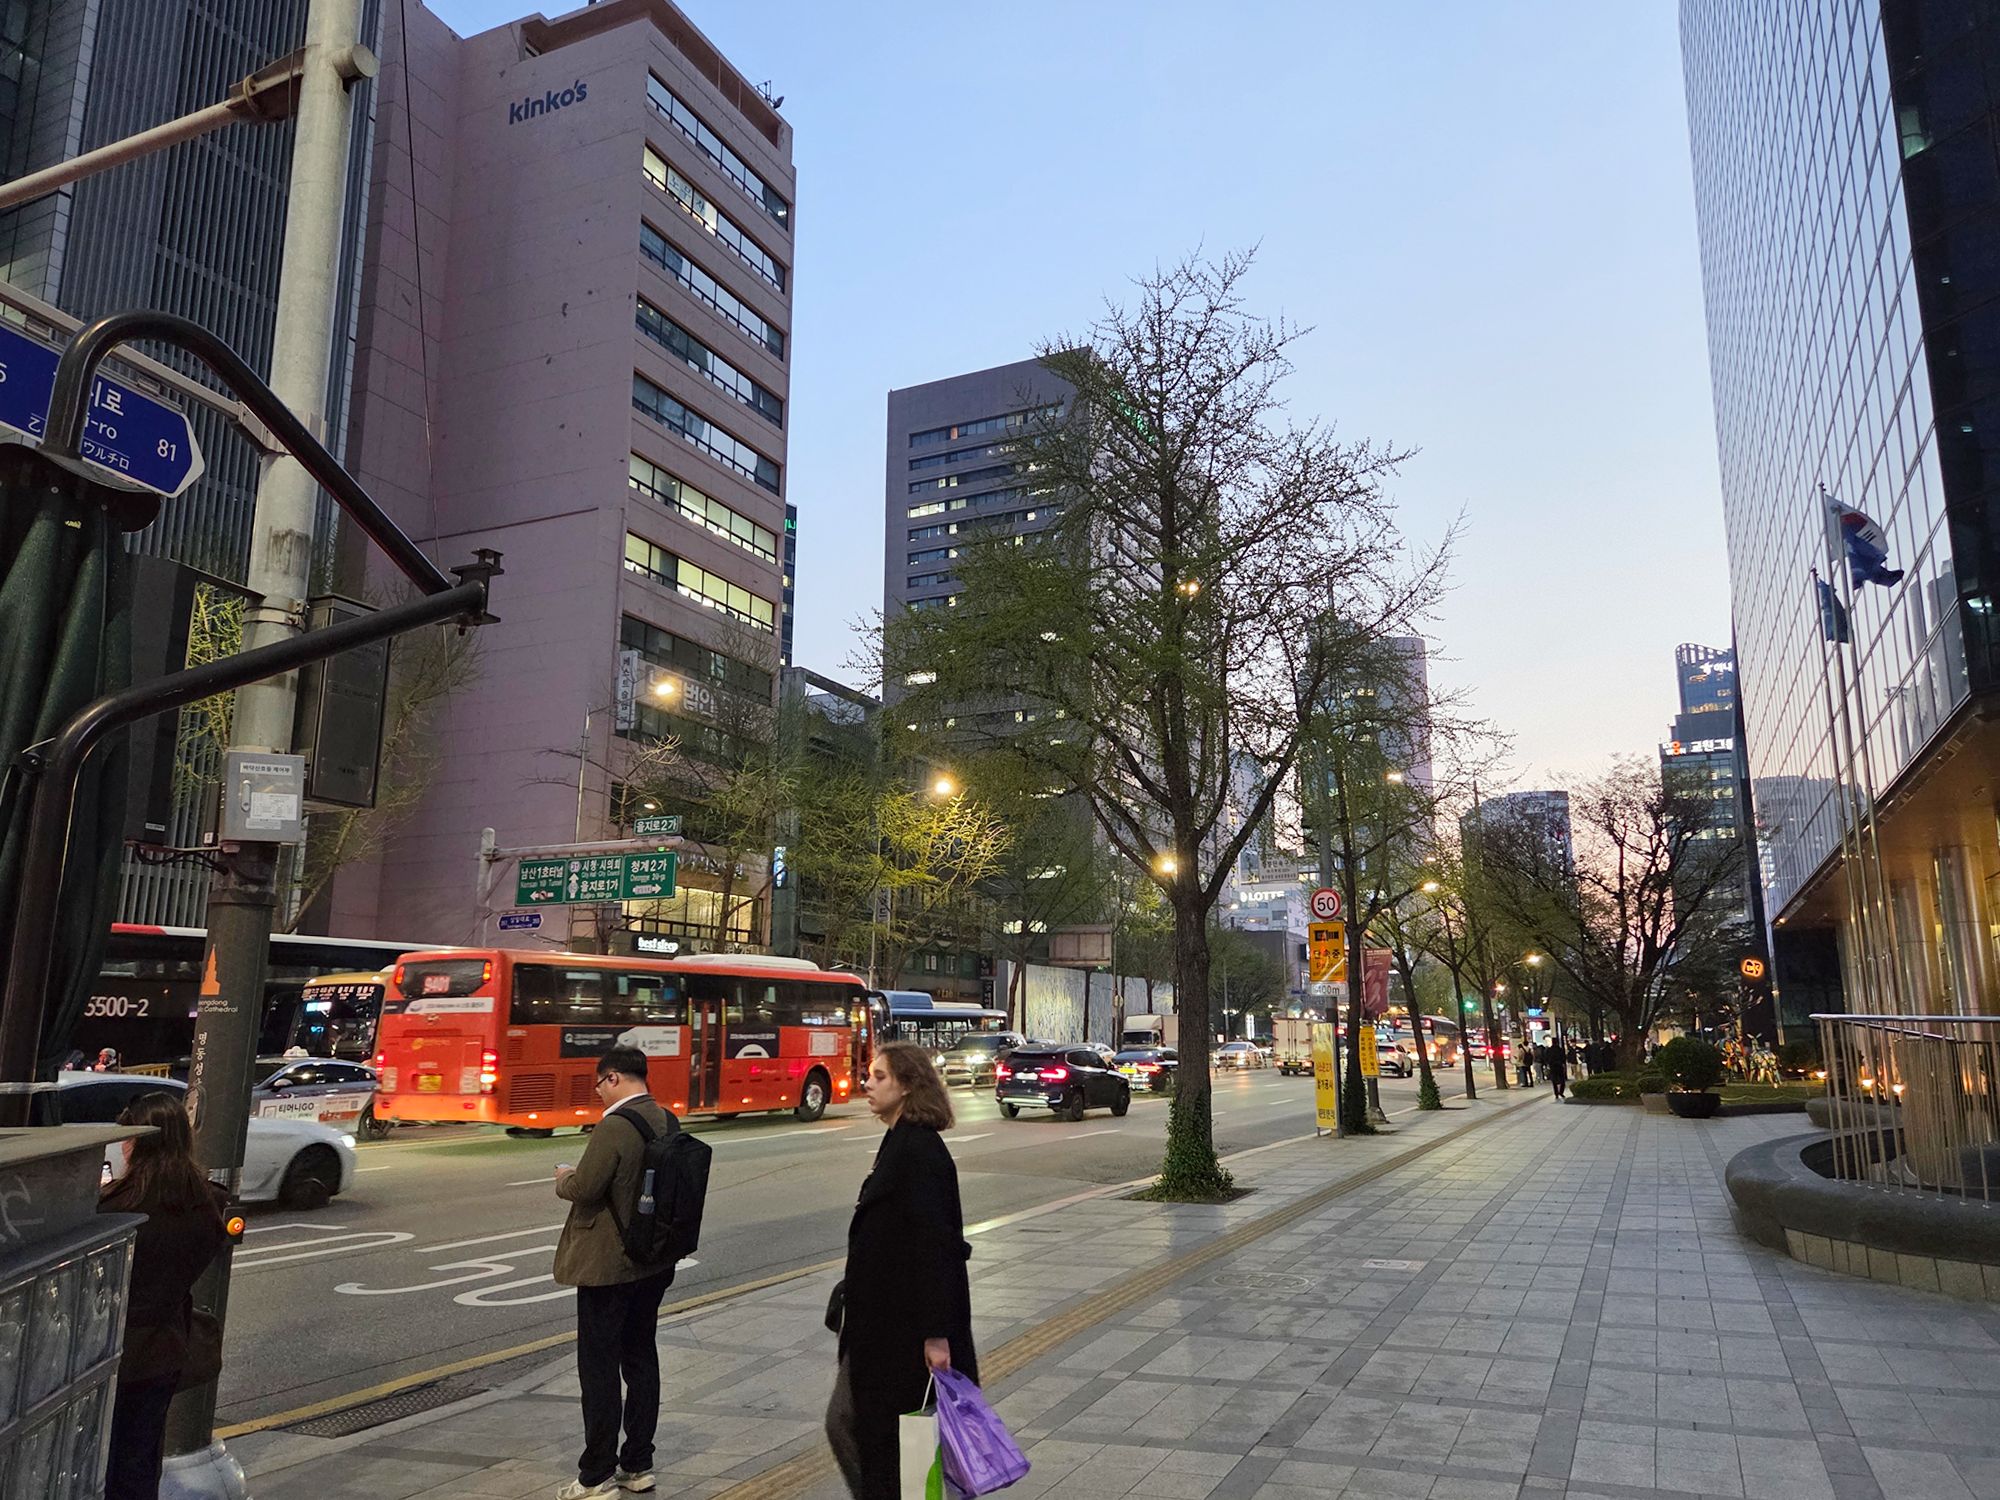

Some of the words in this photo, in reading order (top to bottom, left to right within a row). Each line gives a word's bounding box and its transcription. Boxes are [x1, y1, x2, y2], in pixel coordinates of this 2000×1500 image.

[509, 80, 587, 125] kinko's
[157, 438, 177, 462] 81
[637, 819, 676, 833] 을지로2가
[631, 858, 667, 873] 청계2가
[521, 866, 563, 880] 남산1호터널
[581, 879, 618, 892] 을지로1가
[1248, 890, 1285, 901] LOTTE
[1317, 896, 1335, 911] 50
